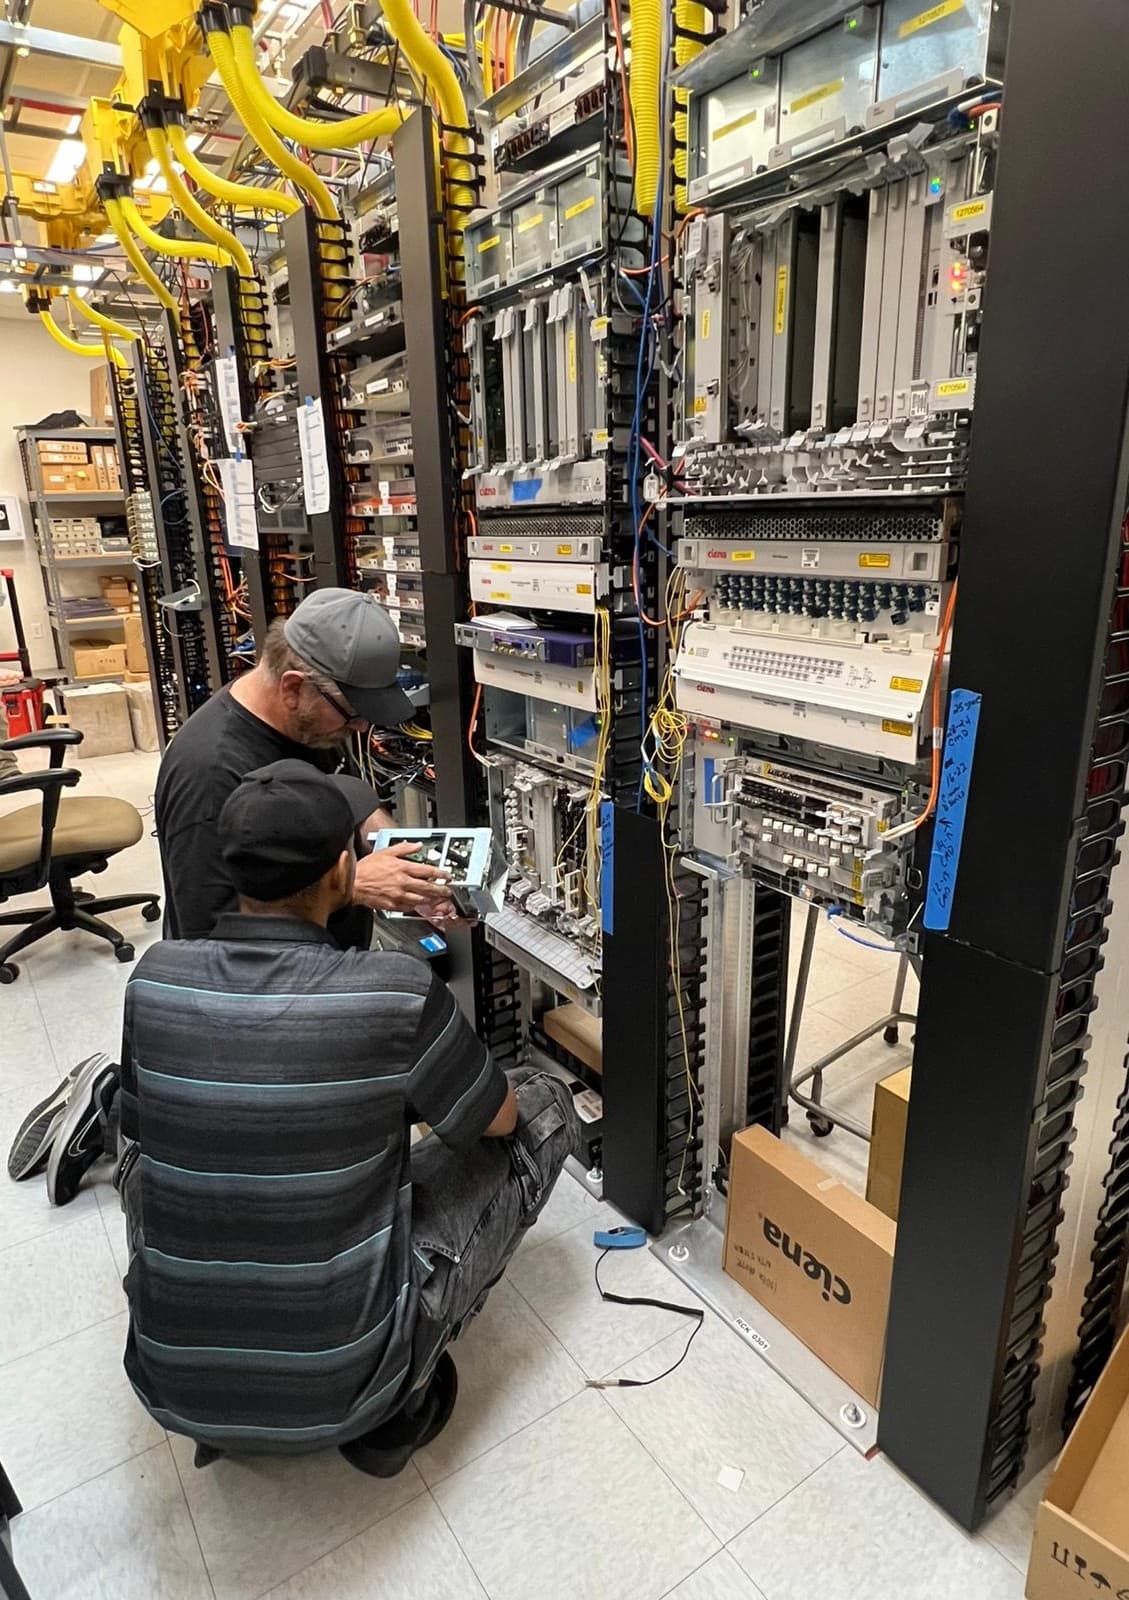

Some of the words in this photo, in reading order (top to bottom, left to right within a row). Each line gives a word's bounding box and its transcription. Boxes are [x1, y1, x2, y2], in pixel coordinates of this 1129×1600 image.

[707, 548, 726, 558] ciena
[763, 1216, 852, 1305] ciena
[736, 1318, 751, 1334] RCK
